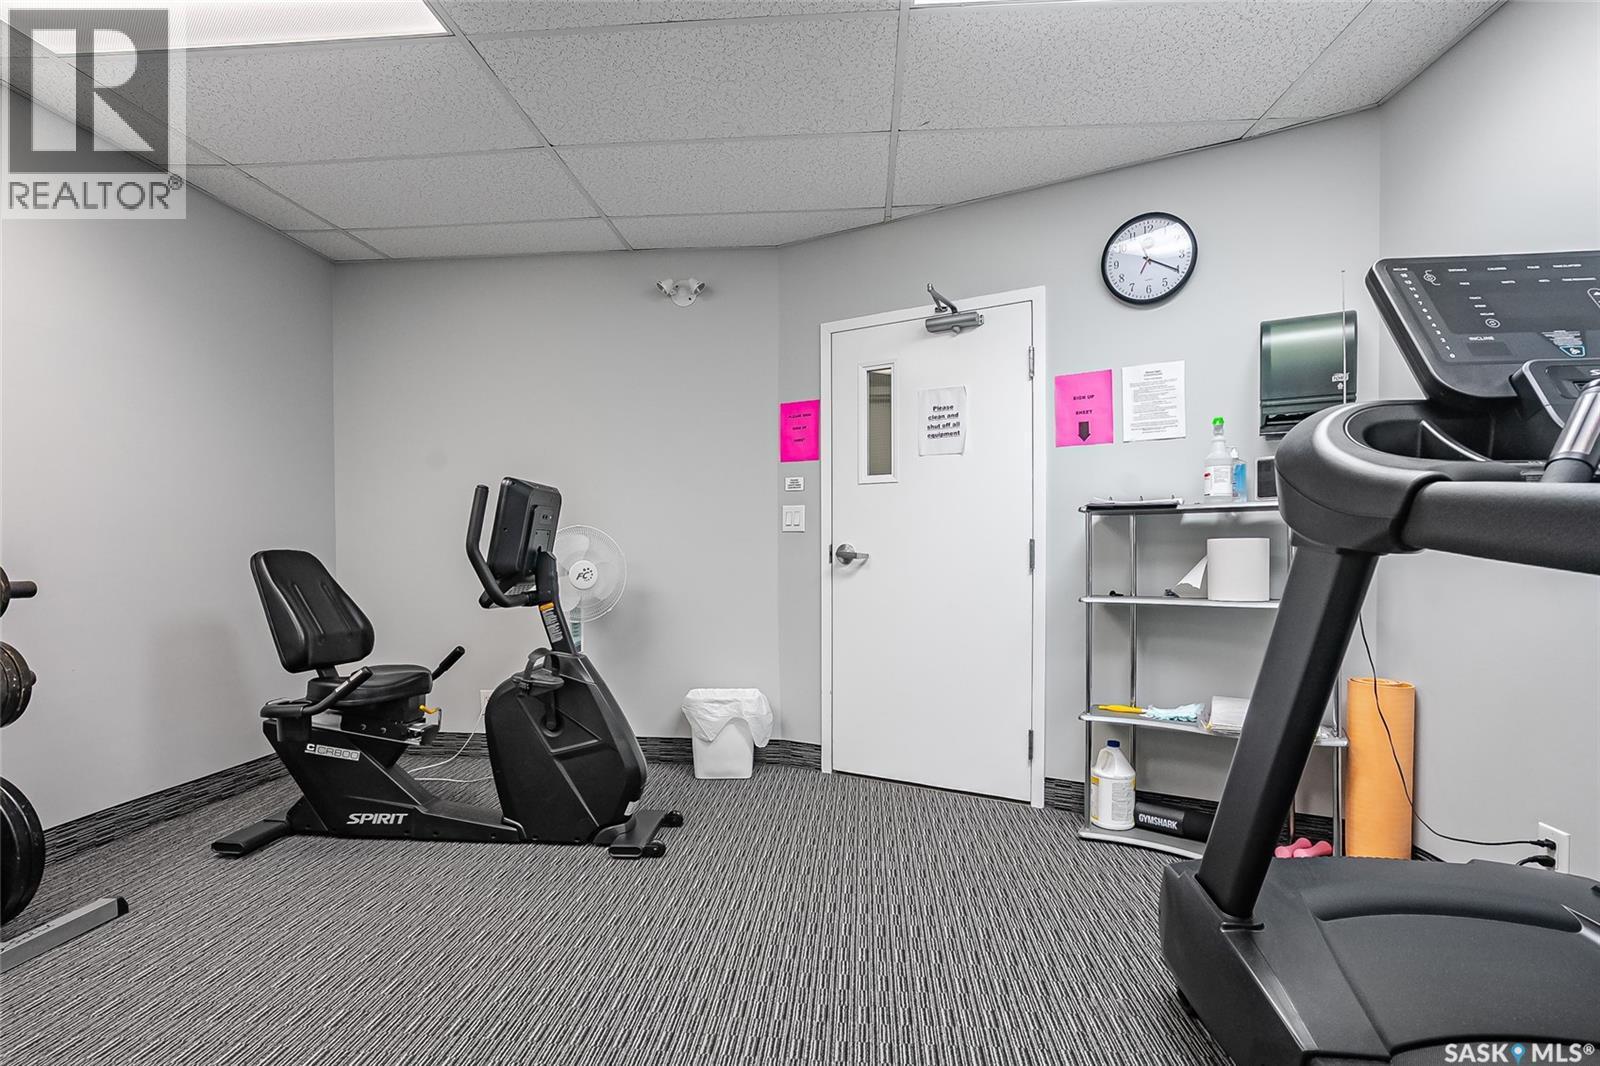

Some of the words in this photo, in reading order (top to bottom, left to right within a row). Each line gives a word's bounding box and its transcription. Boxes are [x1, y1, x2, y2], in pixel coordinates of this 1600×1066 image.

[1143, 225, 1154, 234] 12
[1113, 259, 1120, 270] 9
[1118, 273, 1125, 283] 8
[1161, 277, 1169, 287] 5
[1129, 282, 1136, 292] 7
[1145, 284, 1152, 294] 6
[932, 404, 954, 412] Please
[927, 413, 946, 421] clean
[946, 411, 959, 419] and
[926, 422, 941, 431] shut
[926, 429, 961, 439] equipment
[316, 745, 361, 761] CR800
[346, 813, 409, 825] SPIRIT
[1138, 813, 1179, 831] GYMSHARK
